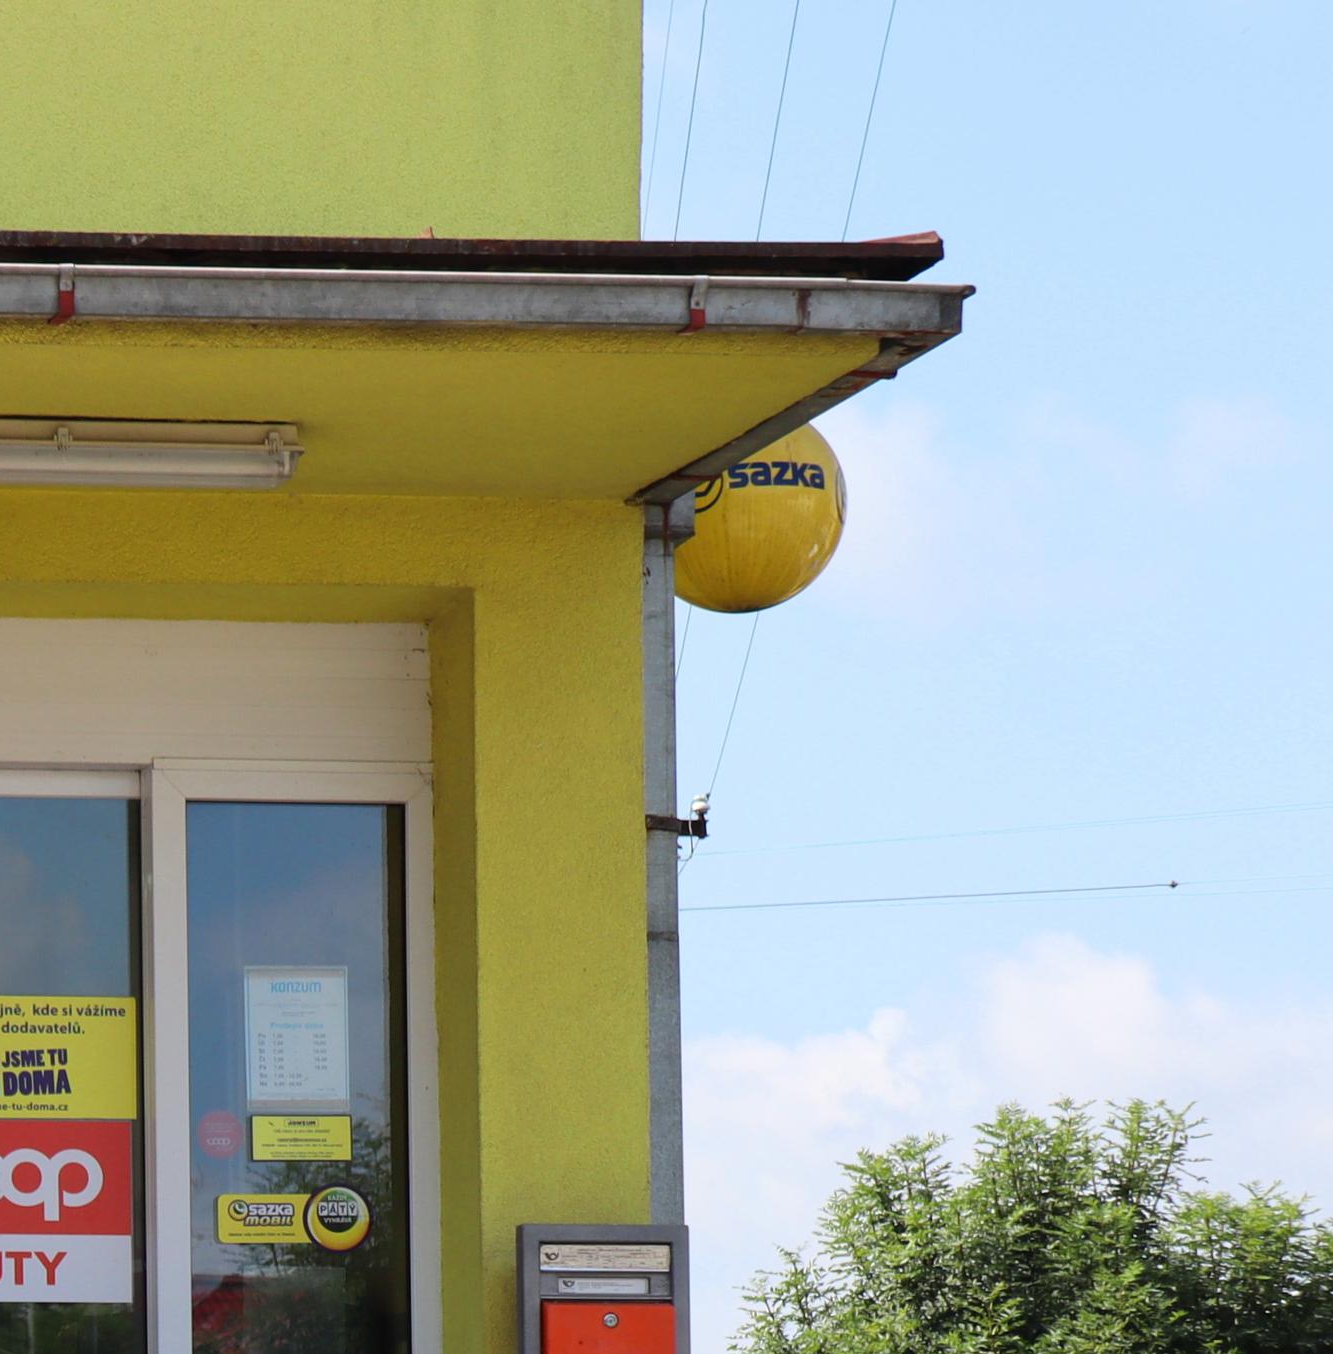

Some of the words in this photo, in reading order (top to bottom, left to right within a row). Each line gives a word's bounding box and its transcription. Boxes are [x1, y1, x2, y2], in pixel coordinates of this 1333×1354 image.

[33, 1004, 58, 1016] kde
[62, 1004, 72, 1016] si
[77, 1003, 126, 1017] vážíme
[1, 1021, 85, 1035] dodavatelů.
[2, 1050, 45, 1068] JSME
[47, 1049, 68, 1066] TU
[3, 1069, 72, 1096] DOMA
[319, 1202, 357, 1215] PÁTÝ
